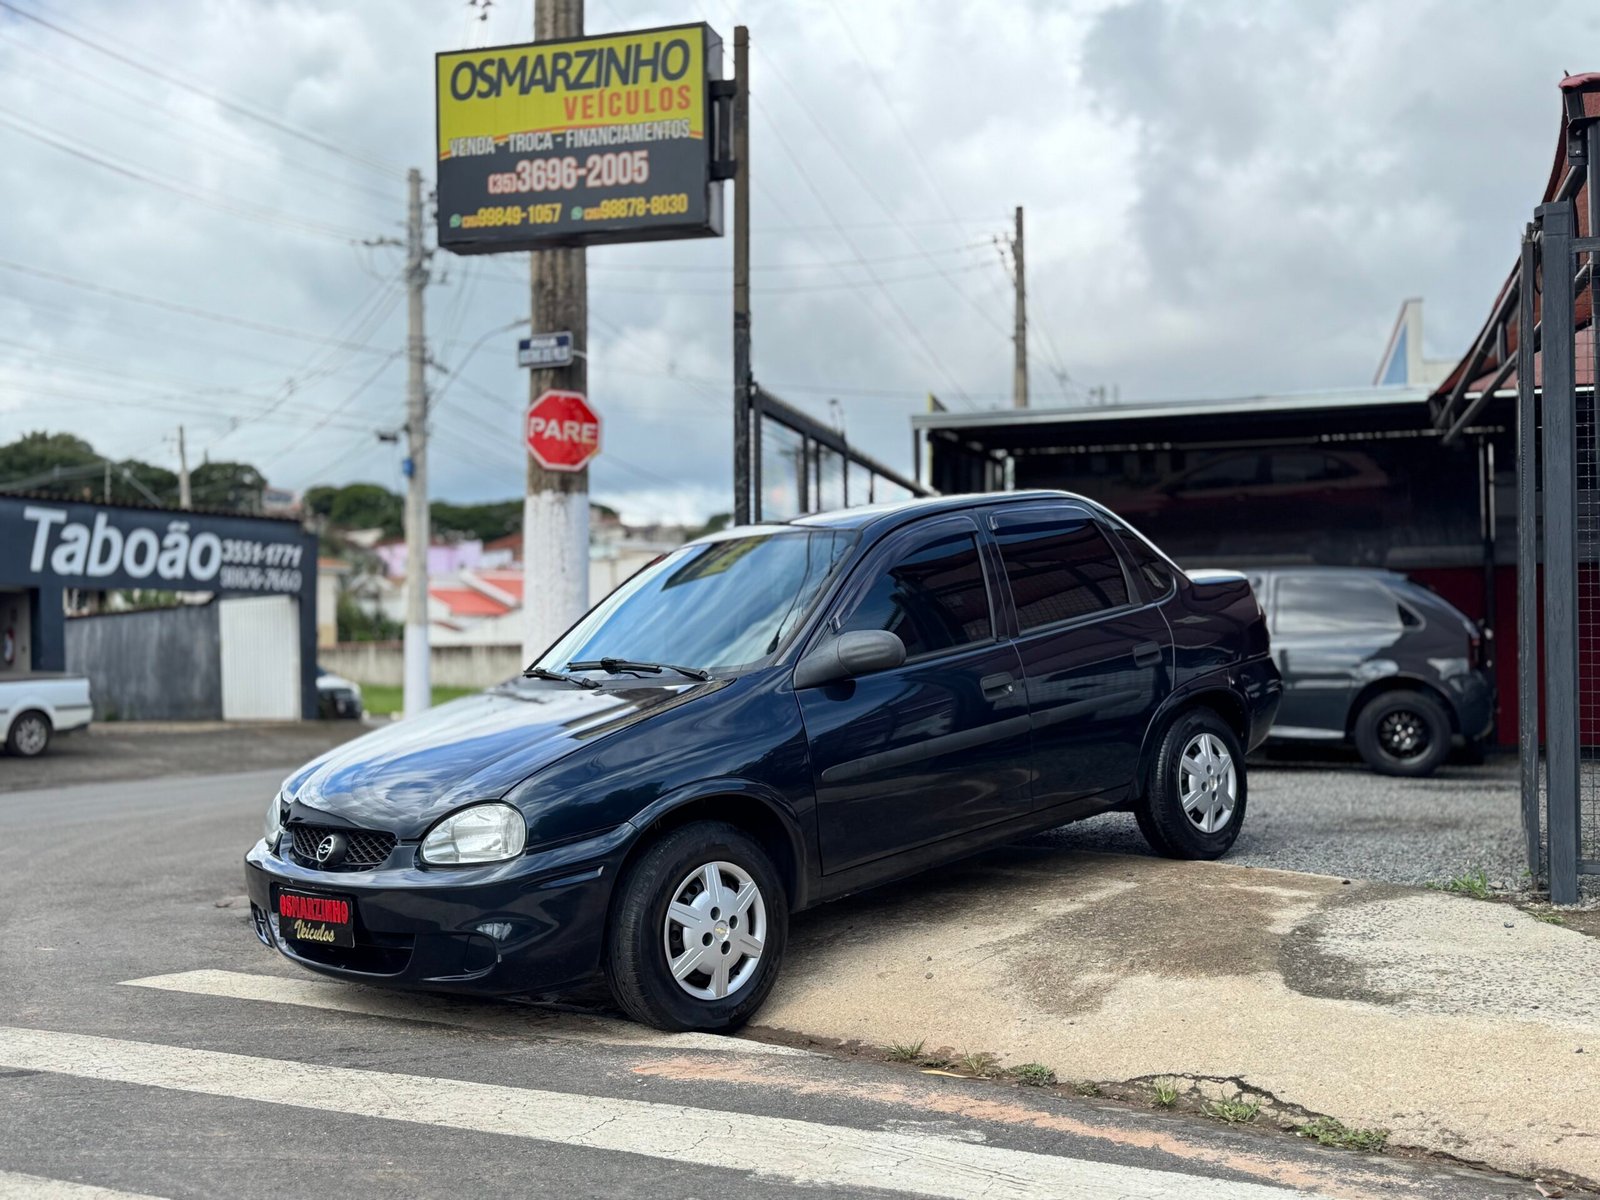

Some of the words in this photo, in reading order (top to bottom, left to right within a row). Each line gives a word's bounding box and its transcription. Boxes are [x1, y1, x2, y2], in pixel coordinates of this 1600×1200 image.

[450, 38, 690, 101] OSMARZINHO
[563, 84, 692, 121] VEÍCULOS
[449, 135, 496, 158] VENDA
[508, 129, 553, 153] TROCA
[565, 119, 690, 149] FINANCIAMENTOS
[529, 416, 597, 445] PARE
[23, 505, 222, 581] Taboão
[279, 894, 349, 924] OSMARZINHO
